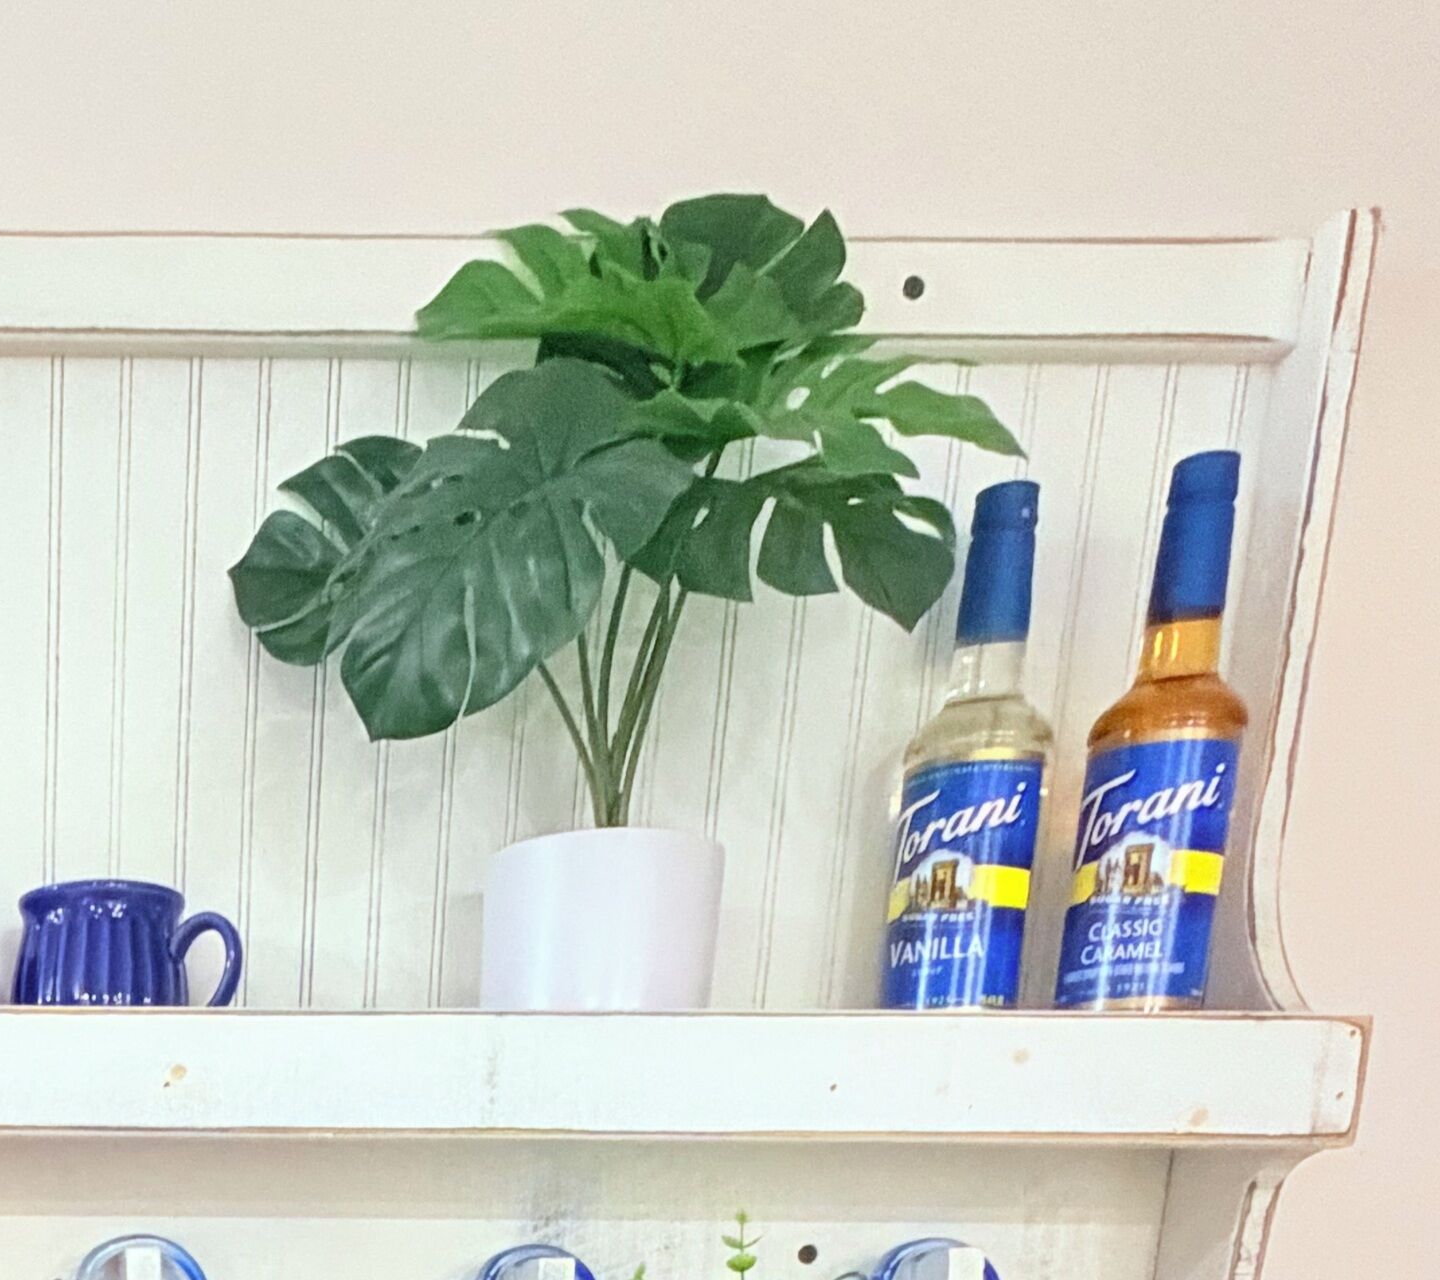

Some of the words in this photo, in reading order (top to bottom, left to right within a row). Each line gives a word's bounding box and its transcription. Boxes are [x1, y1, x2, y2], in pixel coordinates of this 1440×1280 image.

[893, 781, 1027, 886] Torani
[1076, 763, 1225, 871] Torani
[1088, 918, 1163, 942] CLASSIC
[890, 933, 984, 968] VANILLA
[1080, 941, 1163, 965] CARAMEL
